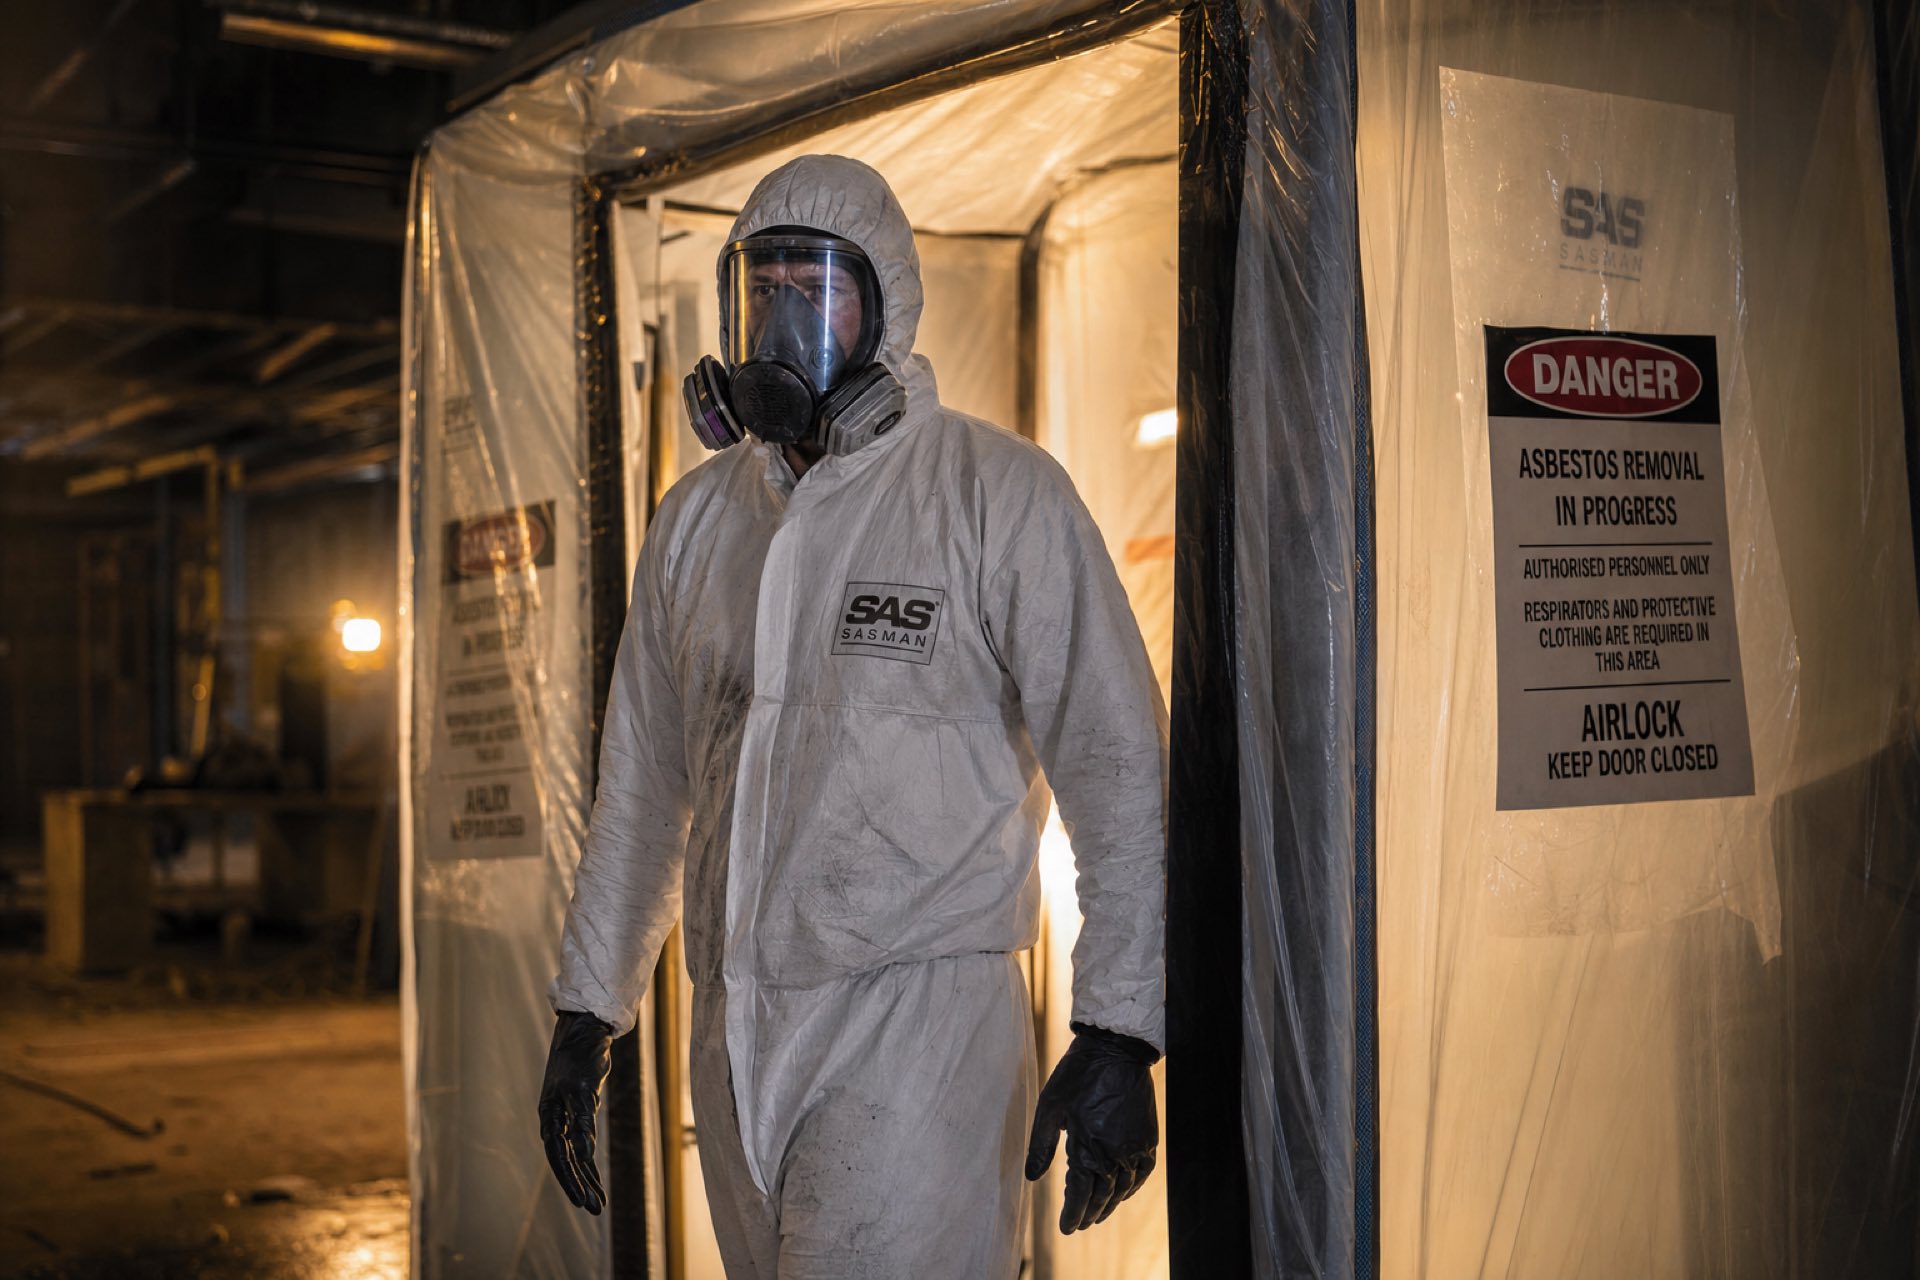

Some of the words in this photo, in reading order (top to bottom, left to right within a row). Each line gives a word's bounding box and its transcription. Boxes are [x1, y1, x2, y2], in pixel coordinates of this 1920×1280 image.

[1560, 186, 1645, 249] SAS
[1560, 243, 1642, 273] SASMAN
[1532, 353, 1680, 400] DANGER
[1519, 448, 1619, 480] ASBESTOS
[1624, 451, 1704, 480] REMOVAL
[1556, 496, 1576, 526] IN
[1584, 496, 1678, 526] PROGRESS
[1524, 558, 1605, 579] AUTHORISED
[1609, 556, 1678, 577] PERSONNEL
[1681, 555, 1710, 575] ONLY
[846, 595, 935, 630] SAS
[1524, 600, 1609, 622] RESPIRATORS
[1613, 598, 1639, 619] AND
[1642, 596, 1716, 618] PROTECTIVE
[841, 628, 926, 647] SASMAN
[1540, 626, 1600, 648] CLOTHING
[1605, 625, 1628, 646] ARE
[1634, 623, 1693, 647] REQUIRED
[1697, 622, 1709, 641] IN
[1595, 652, 1624, 672] THIS
[1627, 650, 1660, 670] AREA
[1582, 700, 1684, 742] AIRLOCK
[1548, 751, 1593, 780] KEEP
[1599, 748, 1646, 776] DOOR
[1651, 744, 1718, 772] CLOSED
